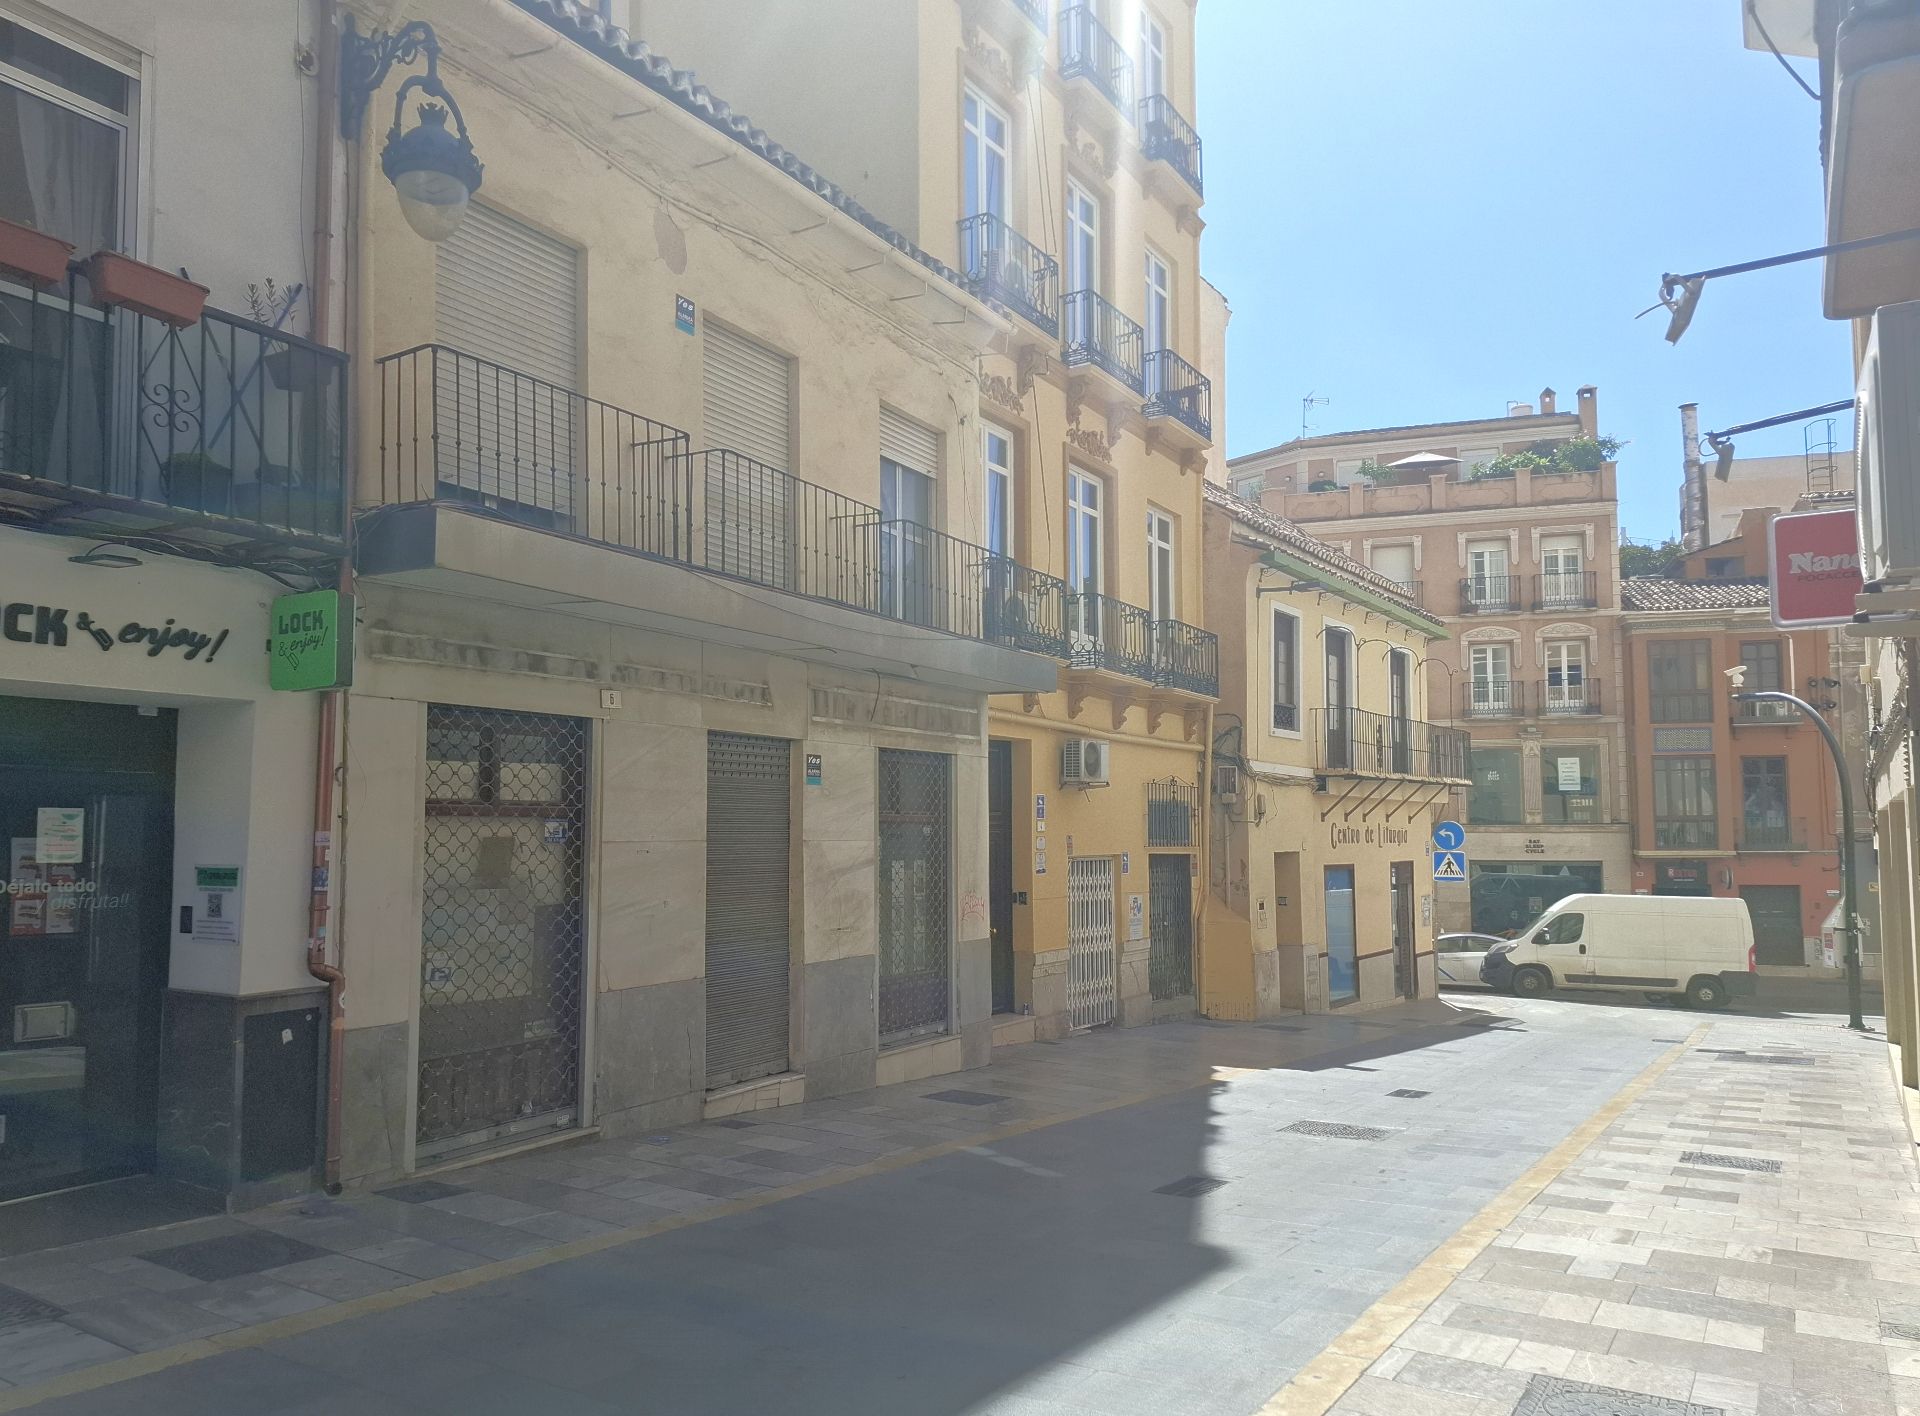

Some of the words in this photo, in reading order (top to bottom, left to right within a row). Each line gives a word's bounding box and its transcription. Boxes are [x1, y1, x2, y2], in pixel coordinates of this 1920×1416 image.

[278, 609, 324, 635] LOCK
[118, 618, 229, 663] enjoy!
[290, 626, 328, 654] enjoy!
[1331, 822, 1360, 849] Centro
[1364, 825, 1375, 844] de
[1378, 822, 1408, 848] Liturgia
[56, 878, 96, 893] todo
